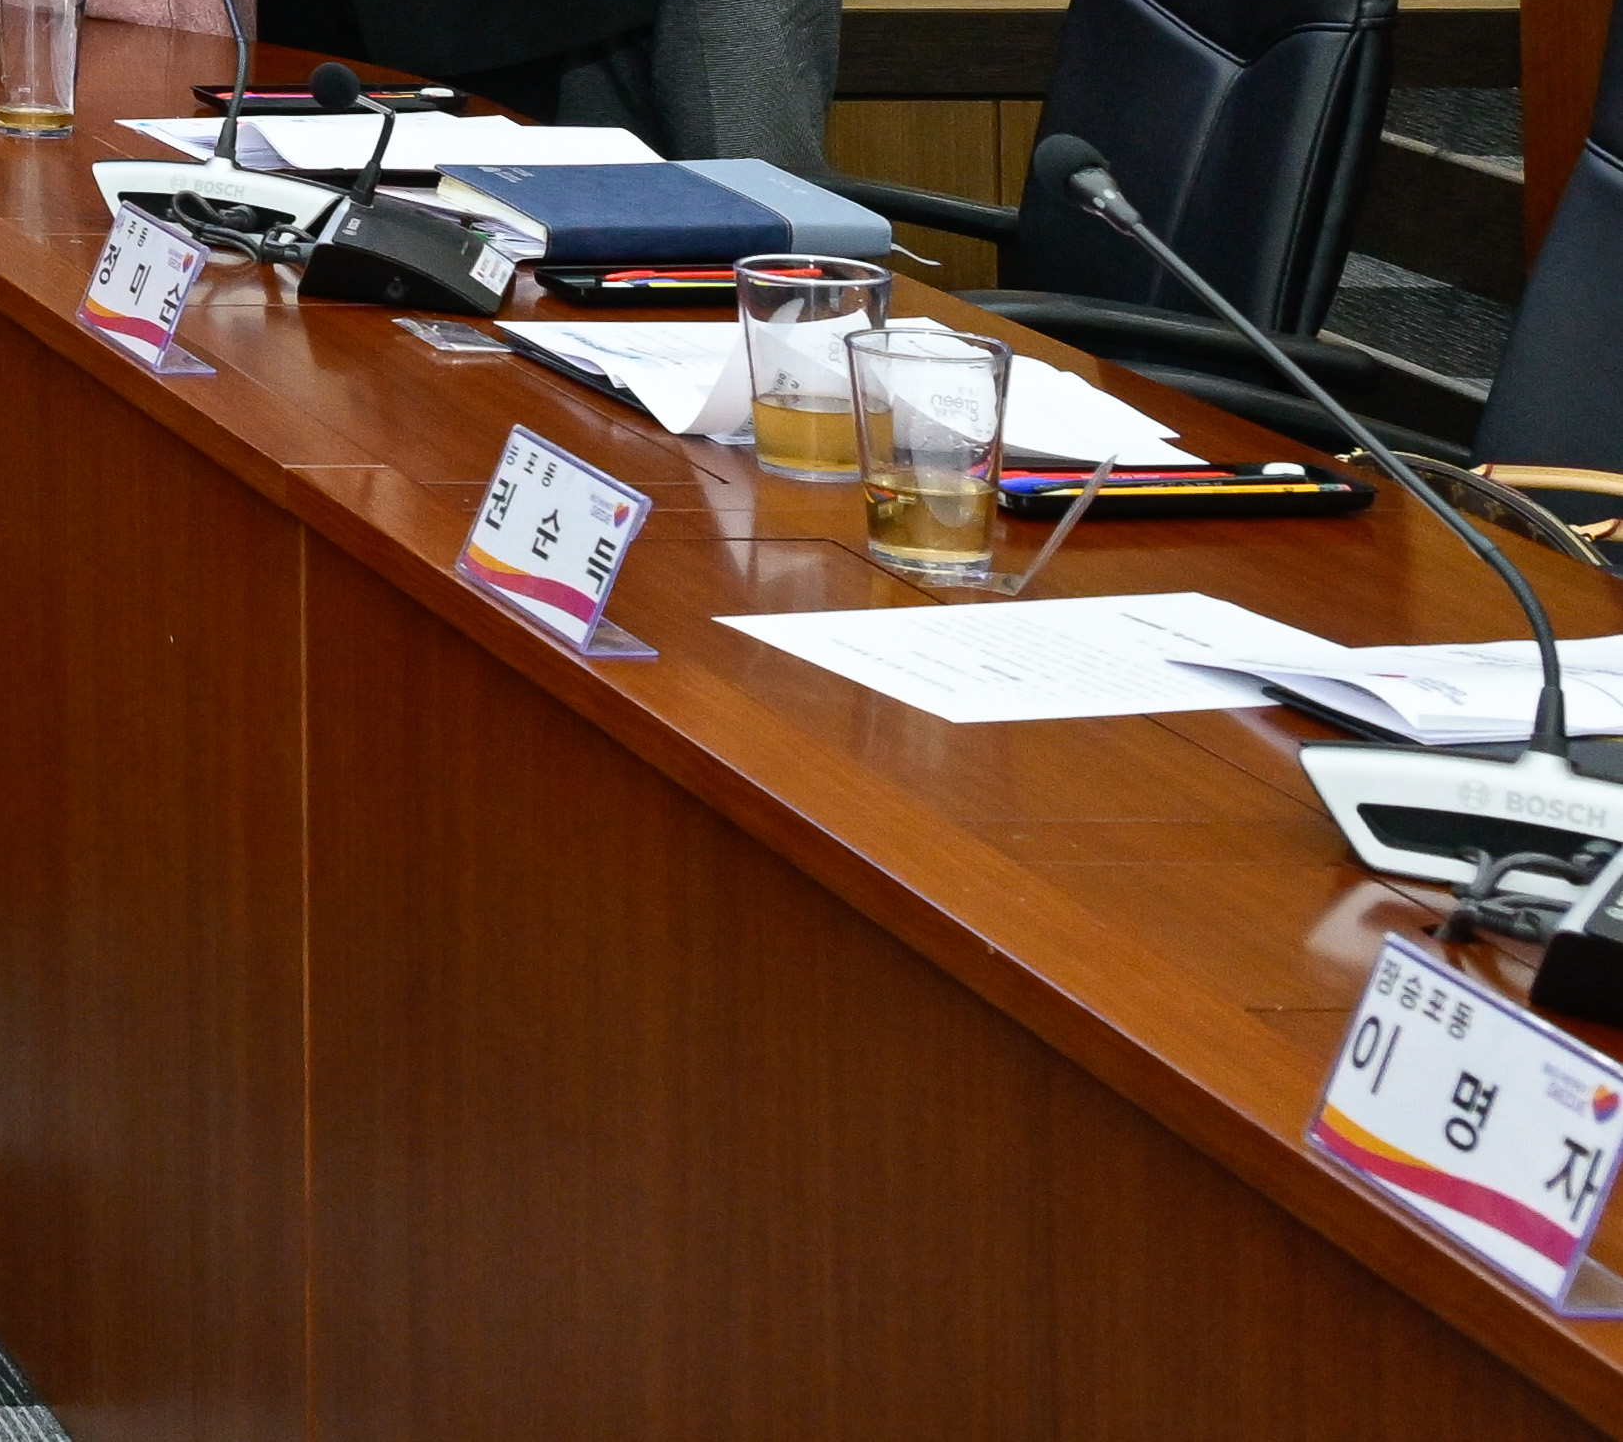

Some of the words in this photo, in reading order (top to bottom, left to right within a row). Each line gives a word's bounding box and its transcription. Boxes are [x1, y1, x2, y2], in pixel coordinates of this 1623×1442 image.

[194, 179, 245, 197] BOSCH
[98, 242, 182, 326] 정미순
[484, 478, 618, 596] 권순득
[1505, 790, 1607, 829] BOSCH
[1351, 1015, 1604, 1222] 이명자
